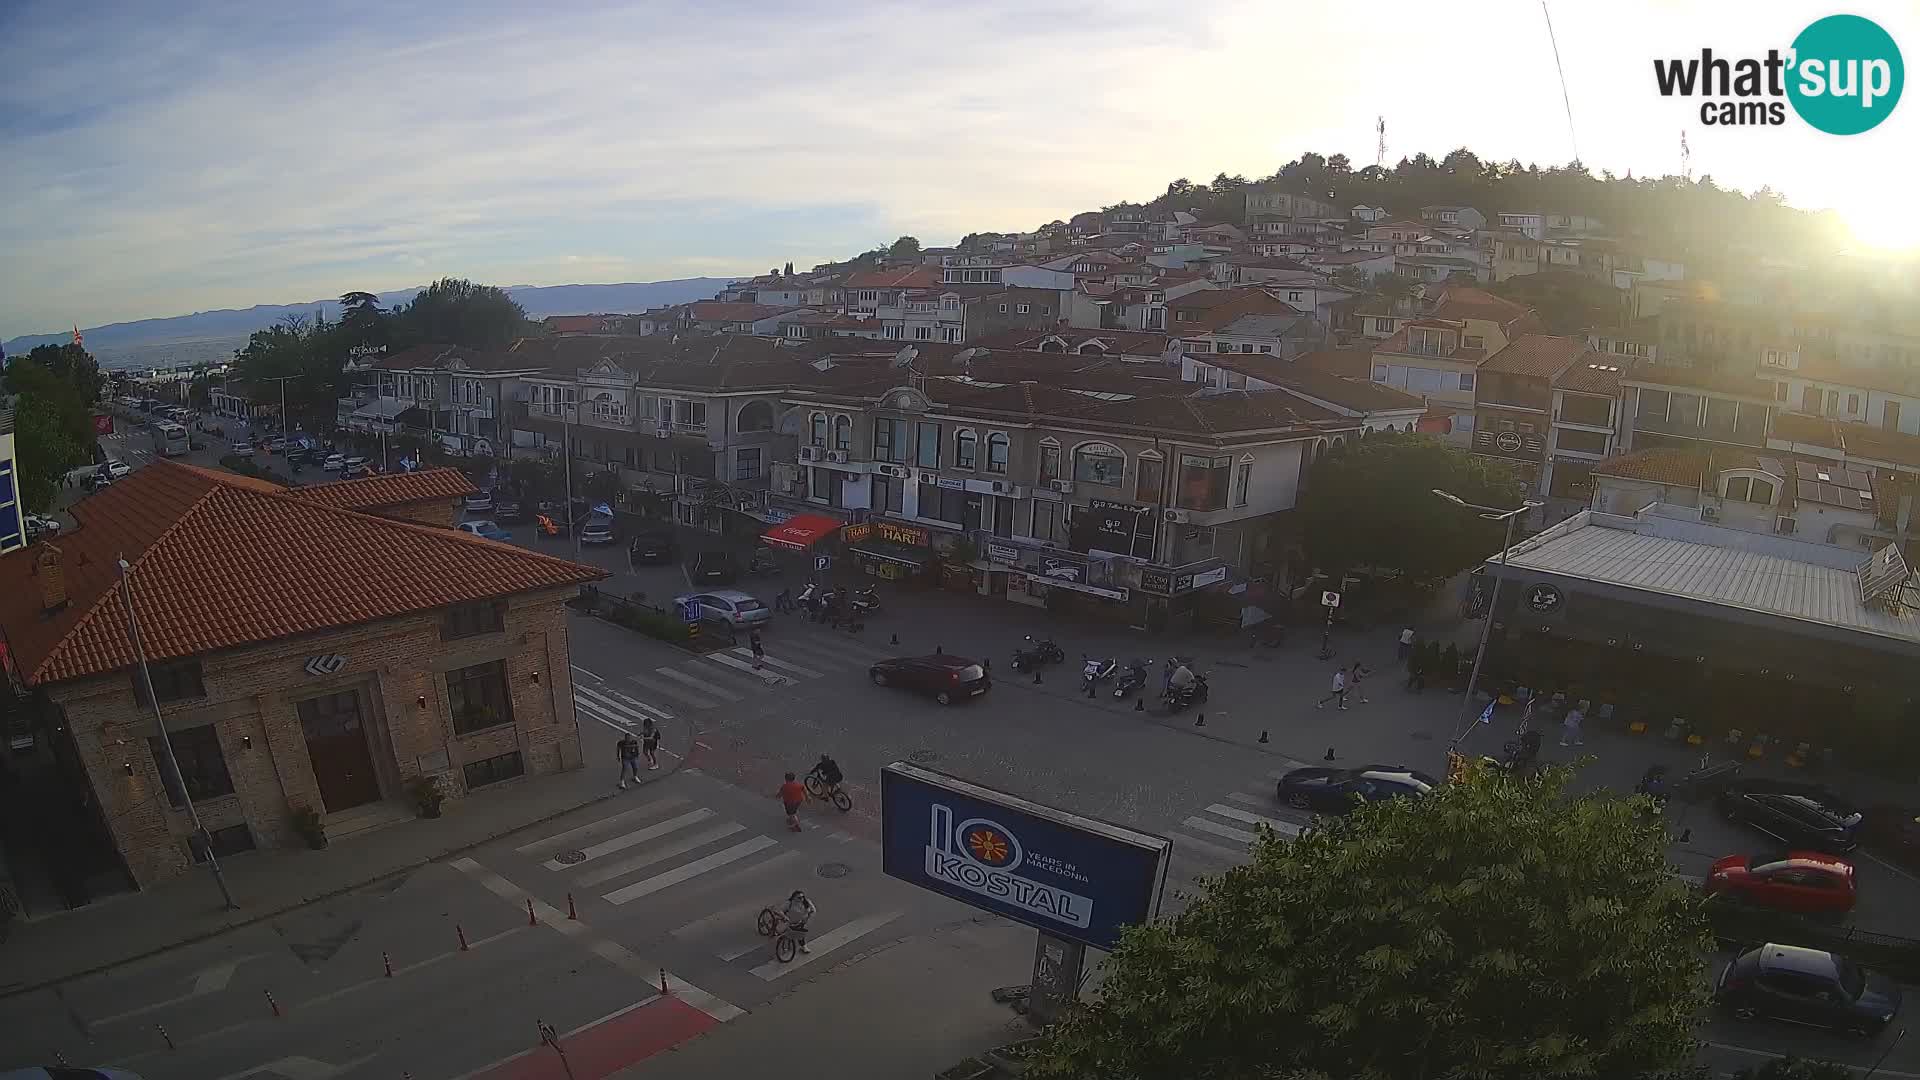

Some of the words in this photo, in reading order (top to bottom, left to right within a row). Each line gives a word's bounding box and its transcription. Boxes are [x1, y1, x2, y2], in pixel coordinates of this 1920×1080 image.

[851, 527, 871, 537] HARI
[883, 529, 916, 545] HARI
[818, 558, 826, 569] P
[1025, 856, 1090, 883] MACEDONIA
[1026, 849, 1063, 869] YEARS
[1064, 862, 1077, 872] IN
[933, 851, 1081, 923] KOSTAL
